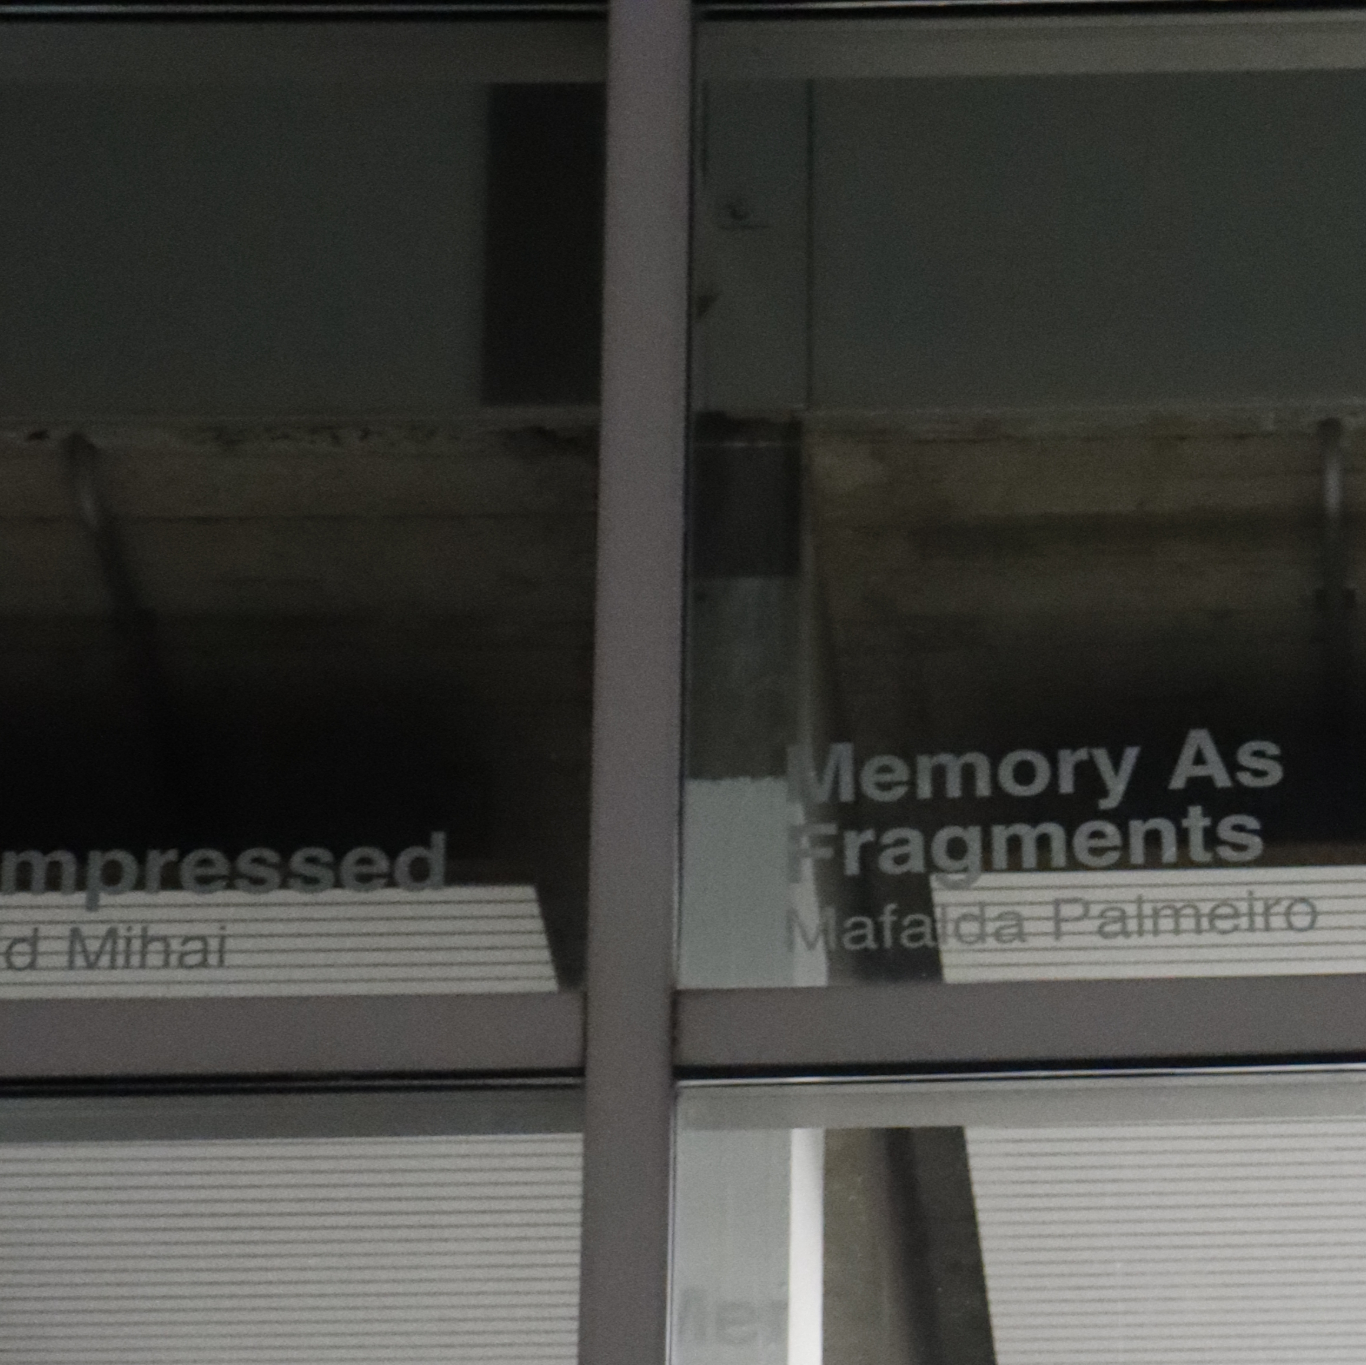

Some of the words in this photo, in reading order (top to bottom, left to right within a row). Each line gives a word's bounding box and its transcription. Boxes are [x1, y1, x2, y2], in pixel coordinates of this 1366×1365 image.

[786, 742, 1142, 809] Memory
[1168, 727, 1285, 791] As
[0, 830, 446, 913] mpressed
[787, 804, 1264, 890] Fragments
[68, 923, 228, 970] Mihai
[786, 898, 1027, 954] Mafalda
[1052, 886, 1319, 942] Palmeiro
